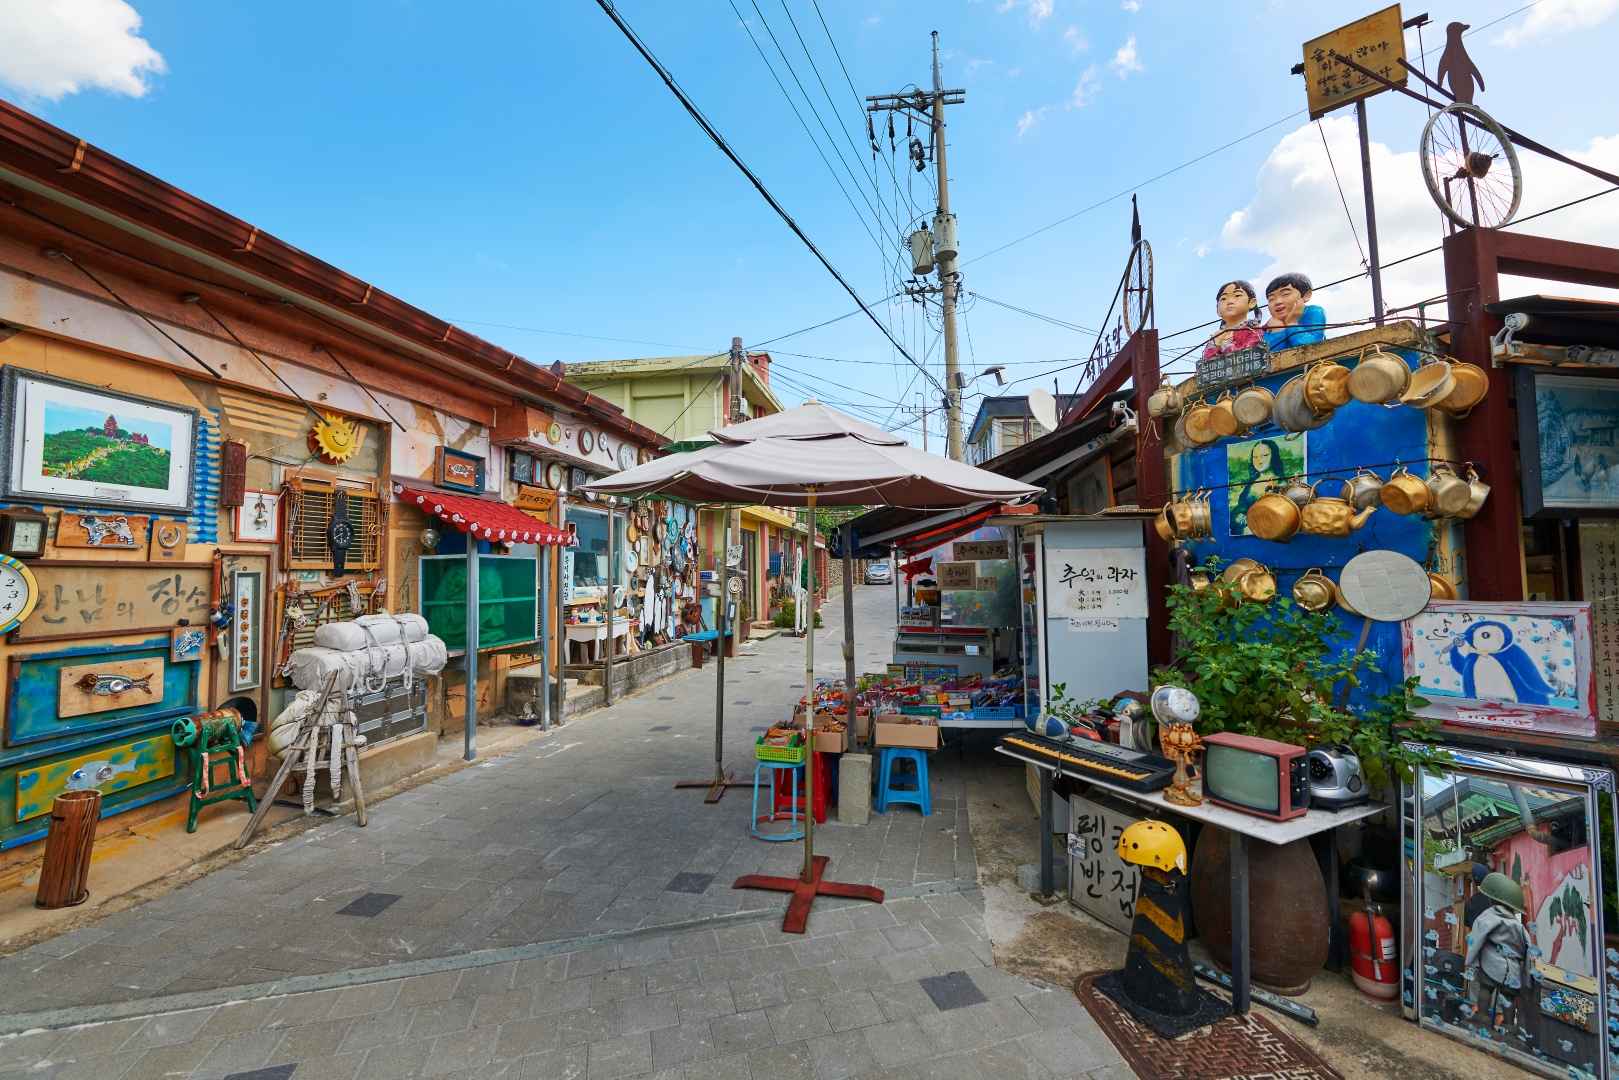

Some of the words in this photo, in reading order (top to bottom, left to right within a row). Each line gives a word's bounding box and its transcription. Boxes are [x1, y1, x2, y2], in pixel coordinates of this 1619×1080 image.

[1059, 563, 1103, 589] 추억의
[1107, 566, 1138, 583] 과자
[147, 574, 209, 616] 장소
